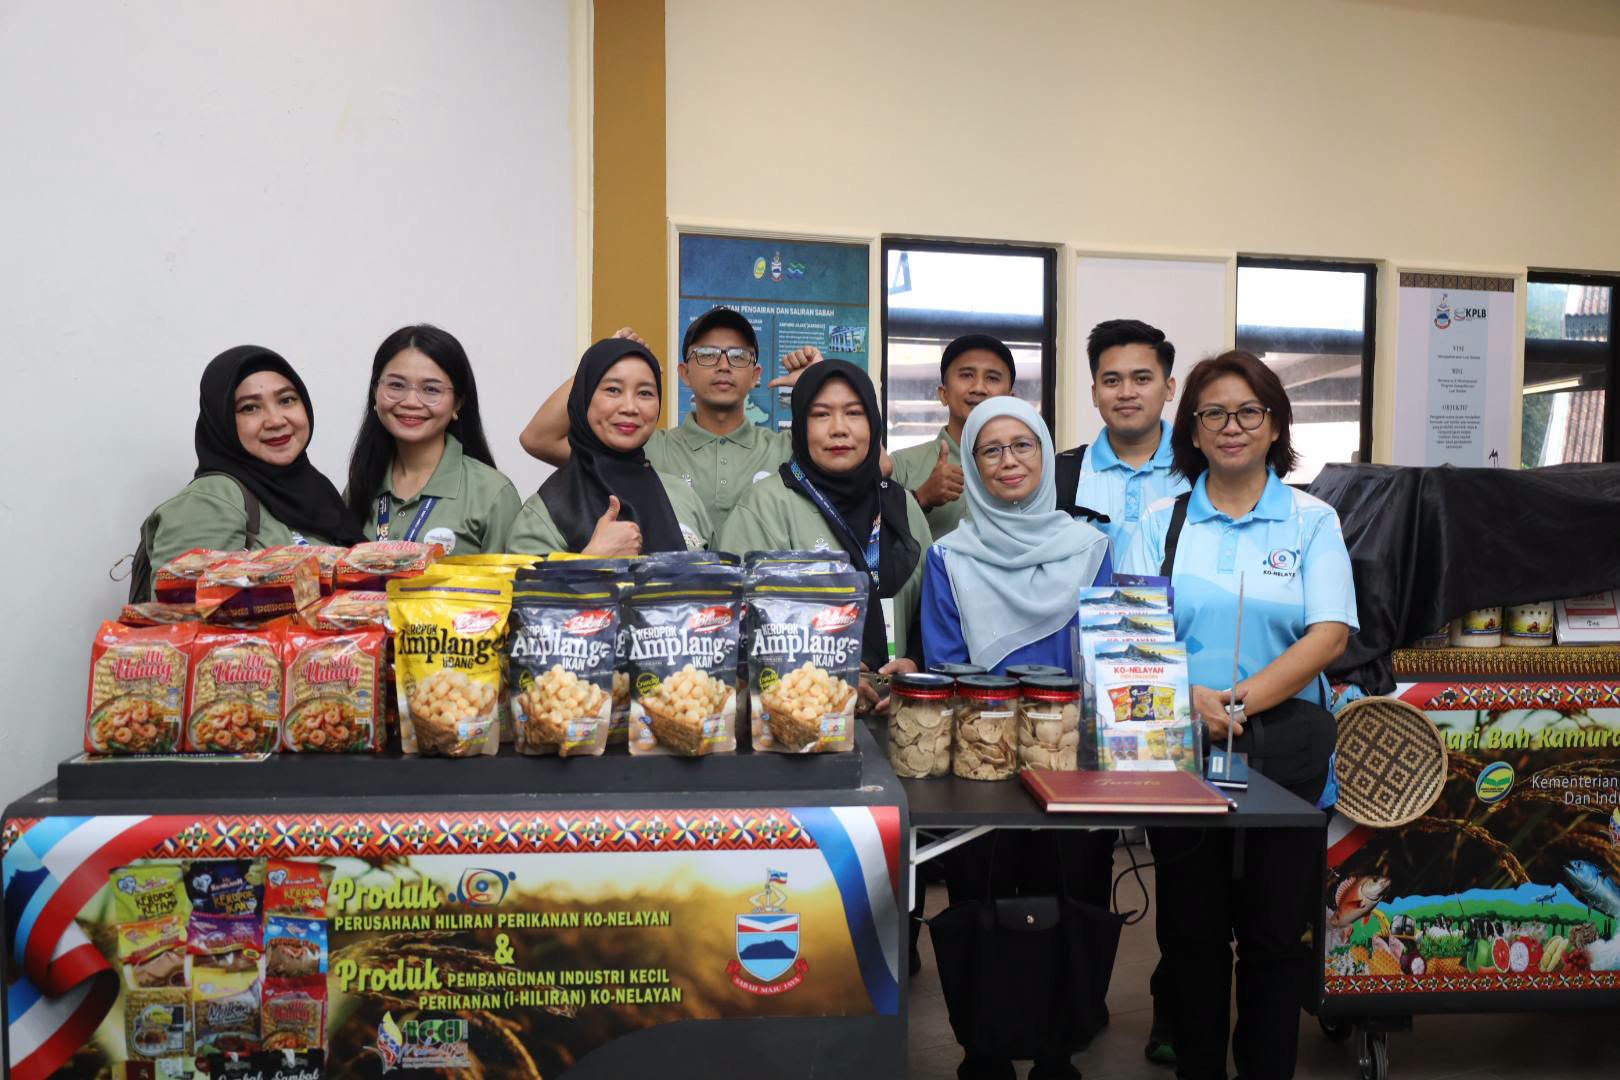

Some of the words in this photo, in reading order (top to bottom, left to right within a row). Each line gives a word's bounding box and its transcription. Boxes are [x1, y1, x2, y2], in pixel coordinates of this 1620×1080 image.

[740, 305, 775, 314] PENGAIRAN
[790, 308, 814, 316] SALIRAN
[1465, 308, 1487, 318] KPLB
[404, 623, 438, 635] EROPOK
[638, 624, 677, 641] KEROPOK
[761, 622, 799, 636] KEROPOK
[398, 628, 493, 665] Amplang
[629, 624, 725, 666] Amplang
[751, 626, 849, 664] Amplang
[442, 656, 475, 669] UDANG
[562, 657, 586, 671] IKAN
[692, 655, 713, 669] IKAN
[812, 654, 834, 668] IKAN
[1113, 666, 1164, 674] KO-NELAYAN
[1488, 728, 1531, 749] Bah
[1532, 774, 1617, 789] Kementerian
[1565, 791, 1590, 805] Dan
[332, 877, 441, 911] Produk
[335, 915, 430, 931] PERUSAHAAN
[435, 914, 493, 929] HILIRAN
[498, 912, 579, 928] PERIKANAN
[584, 911, 670, 927] KO-NELAYAN
[494, 933, 515, 965] &
[335, 958, 443, 993] Produk
[447, 971, 555, 988] PEMBANGUNAN
[560, 970, 625, 985] INDUSTRI
[630, 969, 670, 984] KECIL
[735, 977, 758, 992] SABAH
[760, 985, 781, 993] MAJU
[419, 995, 500, 1010] PERIKANAN
[591, 987, 681, 1004] KO-NELAYAN
